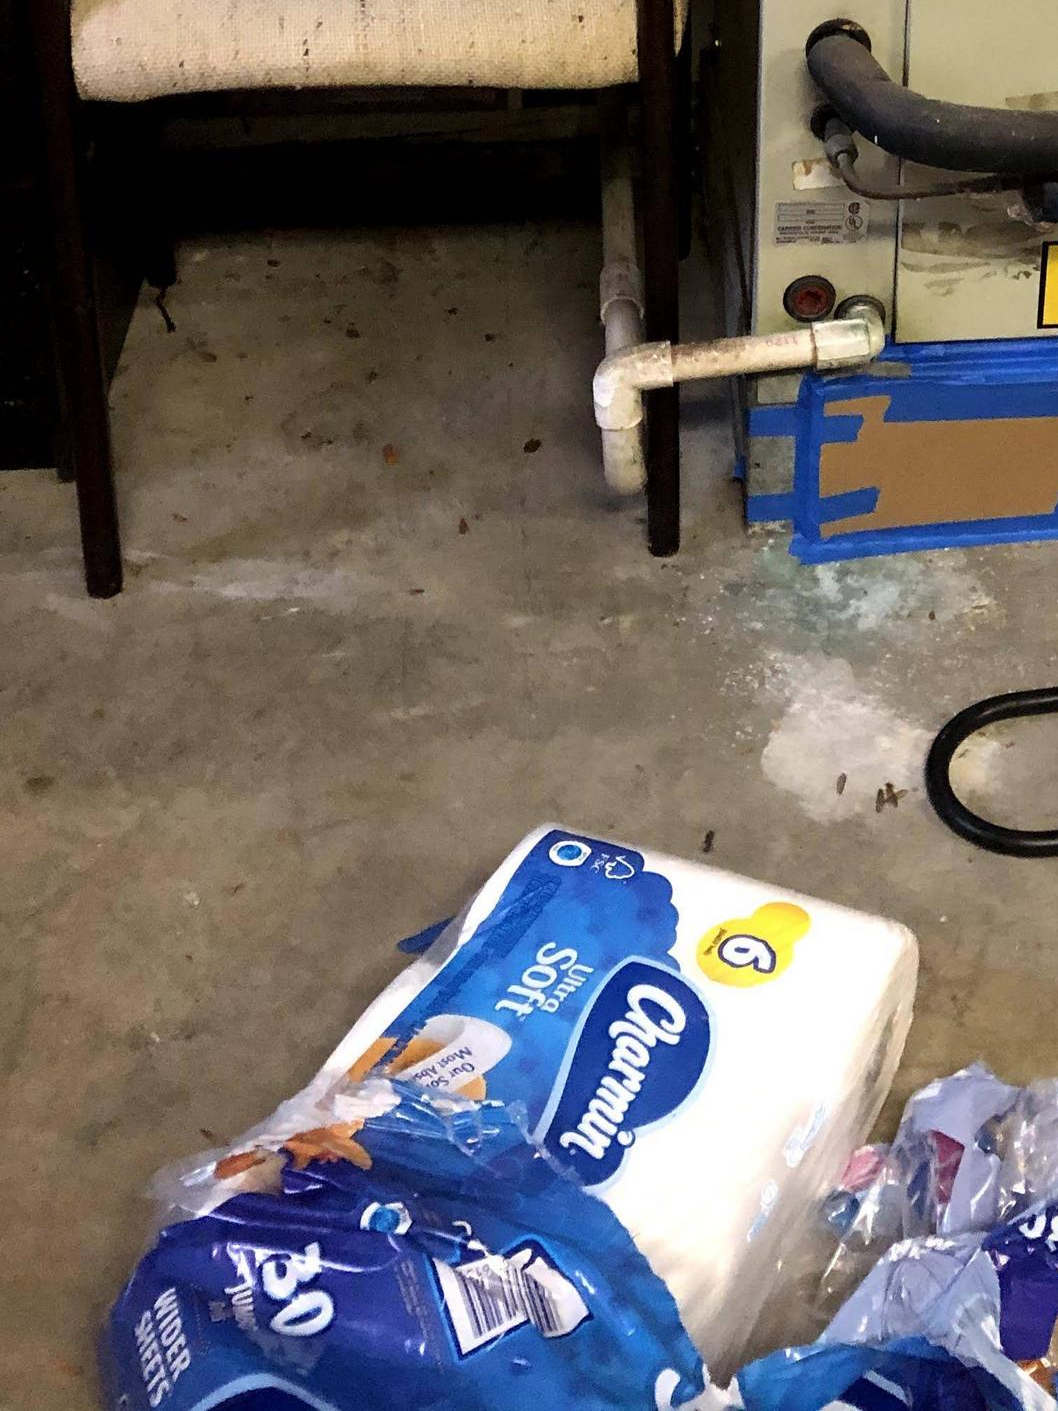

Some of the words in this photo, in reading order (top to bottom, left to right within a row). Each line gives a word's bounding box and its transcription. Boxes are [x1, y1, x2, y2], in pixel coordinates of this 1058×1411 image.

[495, 942, 578, 1019] Soft
[718, 934, 777, 973] 6
[544, 964, 594, 1013] Ultra
[436, 1046, 473, 1068] Most
[448, 1062, 475, 1078] Our
[560, 984, 687, 1160] Charmin
[134, 1310, 171, 1408] SHEETS
[153, 1287, 191, 1383] WIDER
